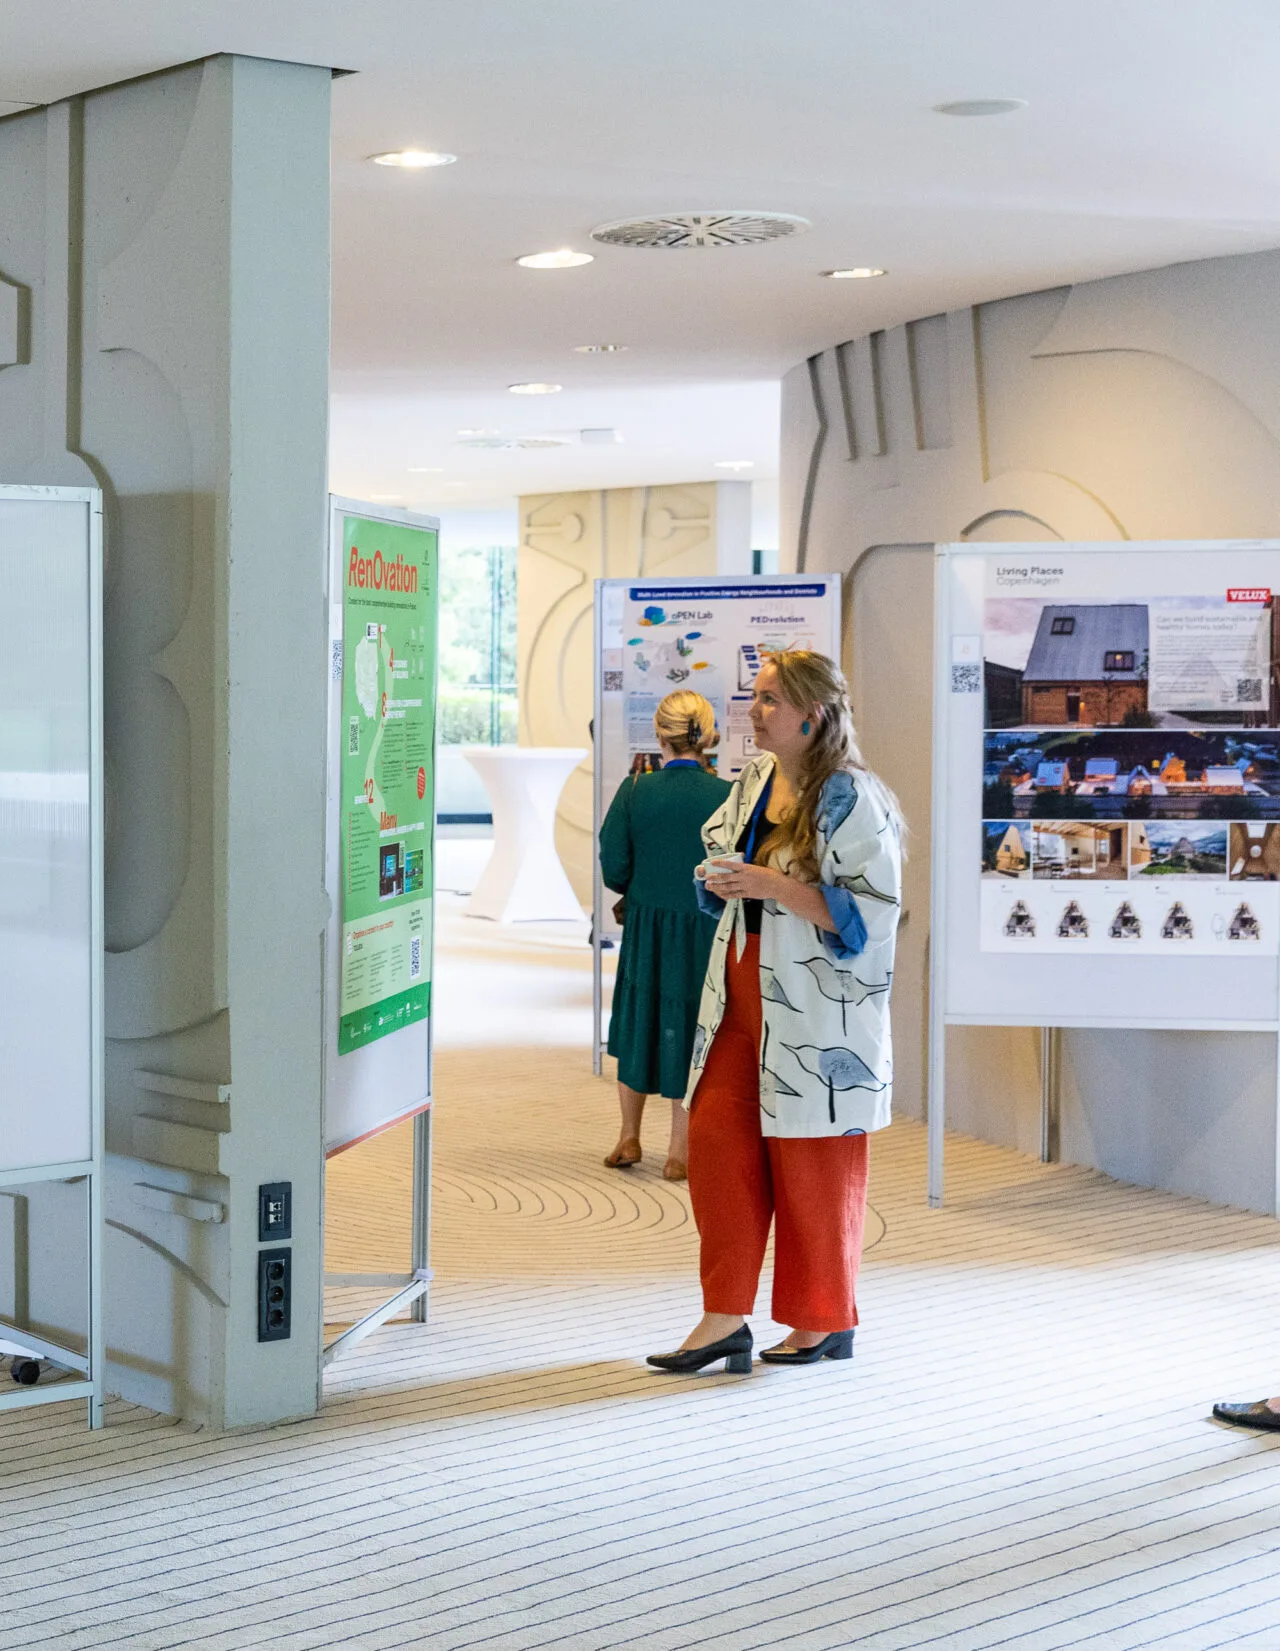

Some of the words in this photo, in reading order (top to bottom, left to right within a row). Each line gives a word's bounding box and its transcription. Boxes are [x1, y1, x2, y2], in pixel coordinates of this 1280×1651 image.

[347, 546, 418, 594] RenOvation
[996, 567, 1029, 577] Living
[1030, 566, 1064, 576] Places
[996, 576, 1060, 587] Copenhagen
[1230, 590, 1268, 600] VELUX
[697, 611, 713, 620] Lab
[389, 647, 395, 673] 4
[363, 778, 375, 805] 12
[380, 811, 398, 831] Many
